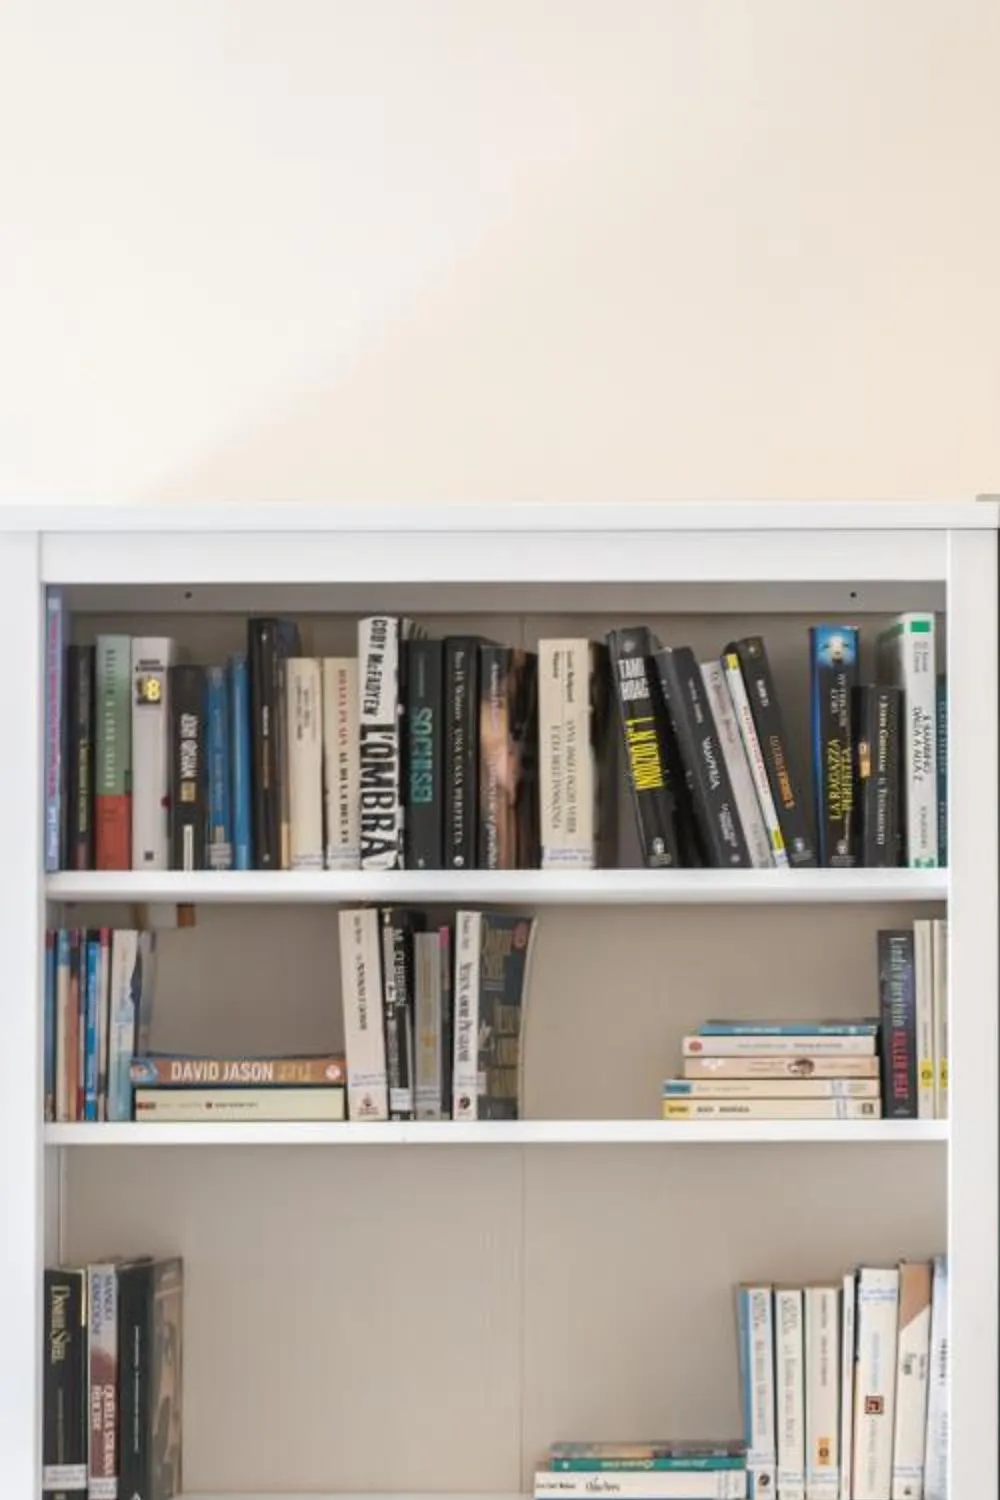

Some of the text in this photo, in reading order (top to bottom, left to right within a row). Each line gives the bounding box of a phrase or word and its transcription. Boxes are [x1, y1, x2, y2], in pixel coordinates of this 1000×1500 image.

[363, 619, 388, 717] CODY McFADYEN
[411, 707, 432, 734] SO
[360, 724, 397, 858] L'OMBRA
[889, 937, 909, 970] Linda
[171, 1061, 274, 1082] DAVID JASON
